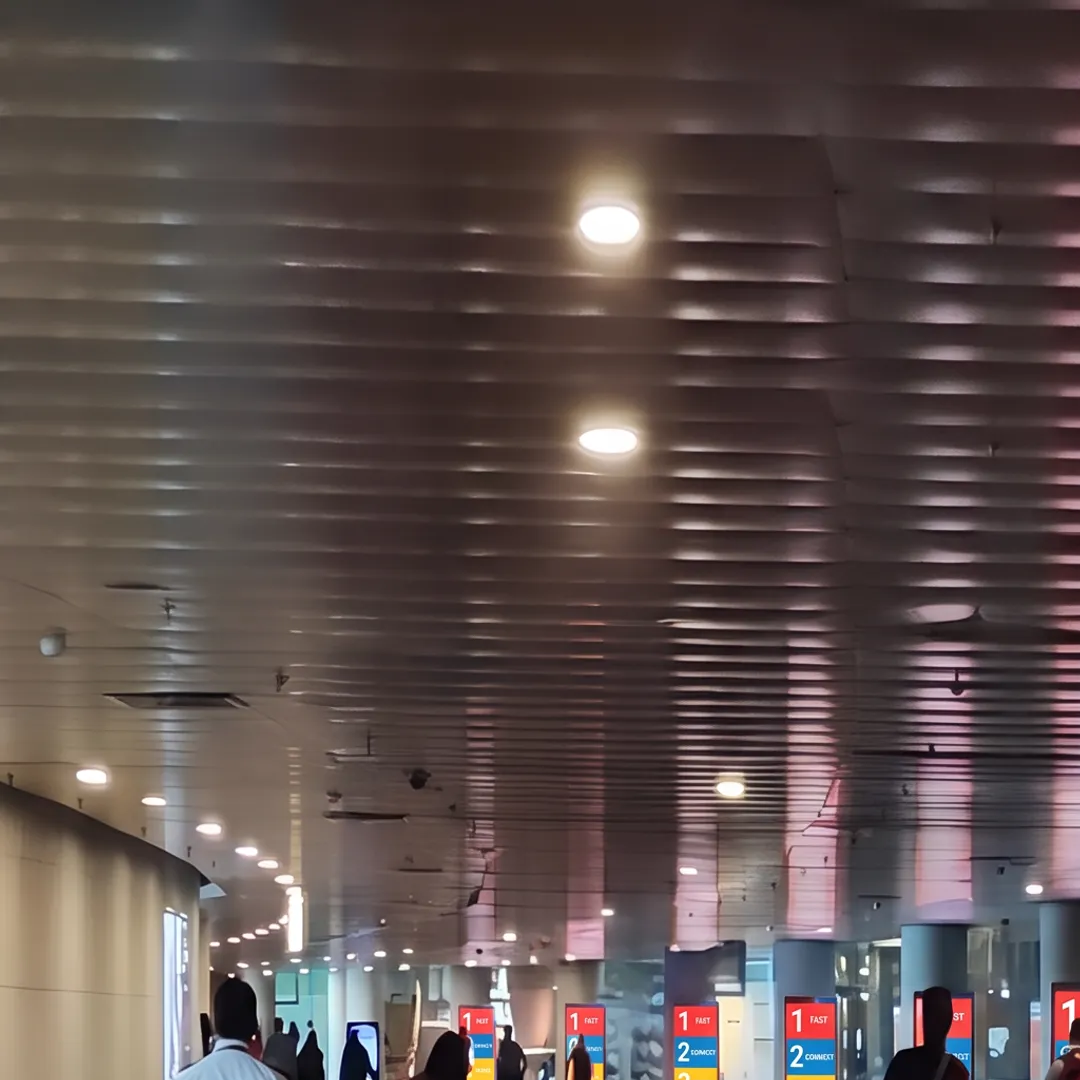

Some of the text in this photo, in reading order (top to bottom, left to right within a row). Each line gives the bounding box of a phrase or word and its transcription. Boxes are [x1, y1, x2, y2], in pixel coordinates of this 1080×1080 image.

[570, 1012, 578, 1031] 1
[679, 1011, 688, 1031] 1
[791, 1008, 828, 1033] 1 FAST
[678, 1041, 690, 1063] 2
[789, 1044, 804, 1068] 2
